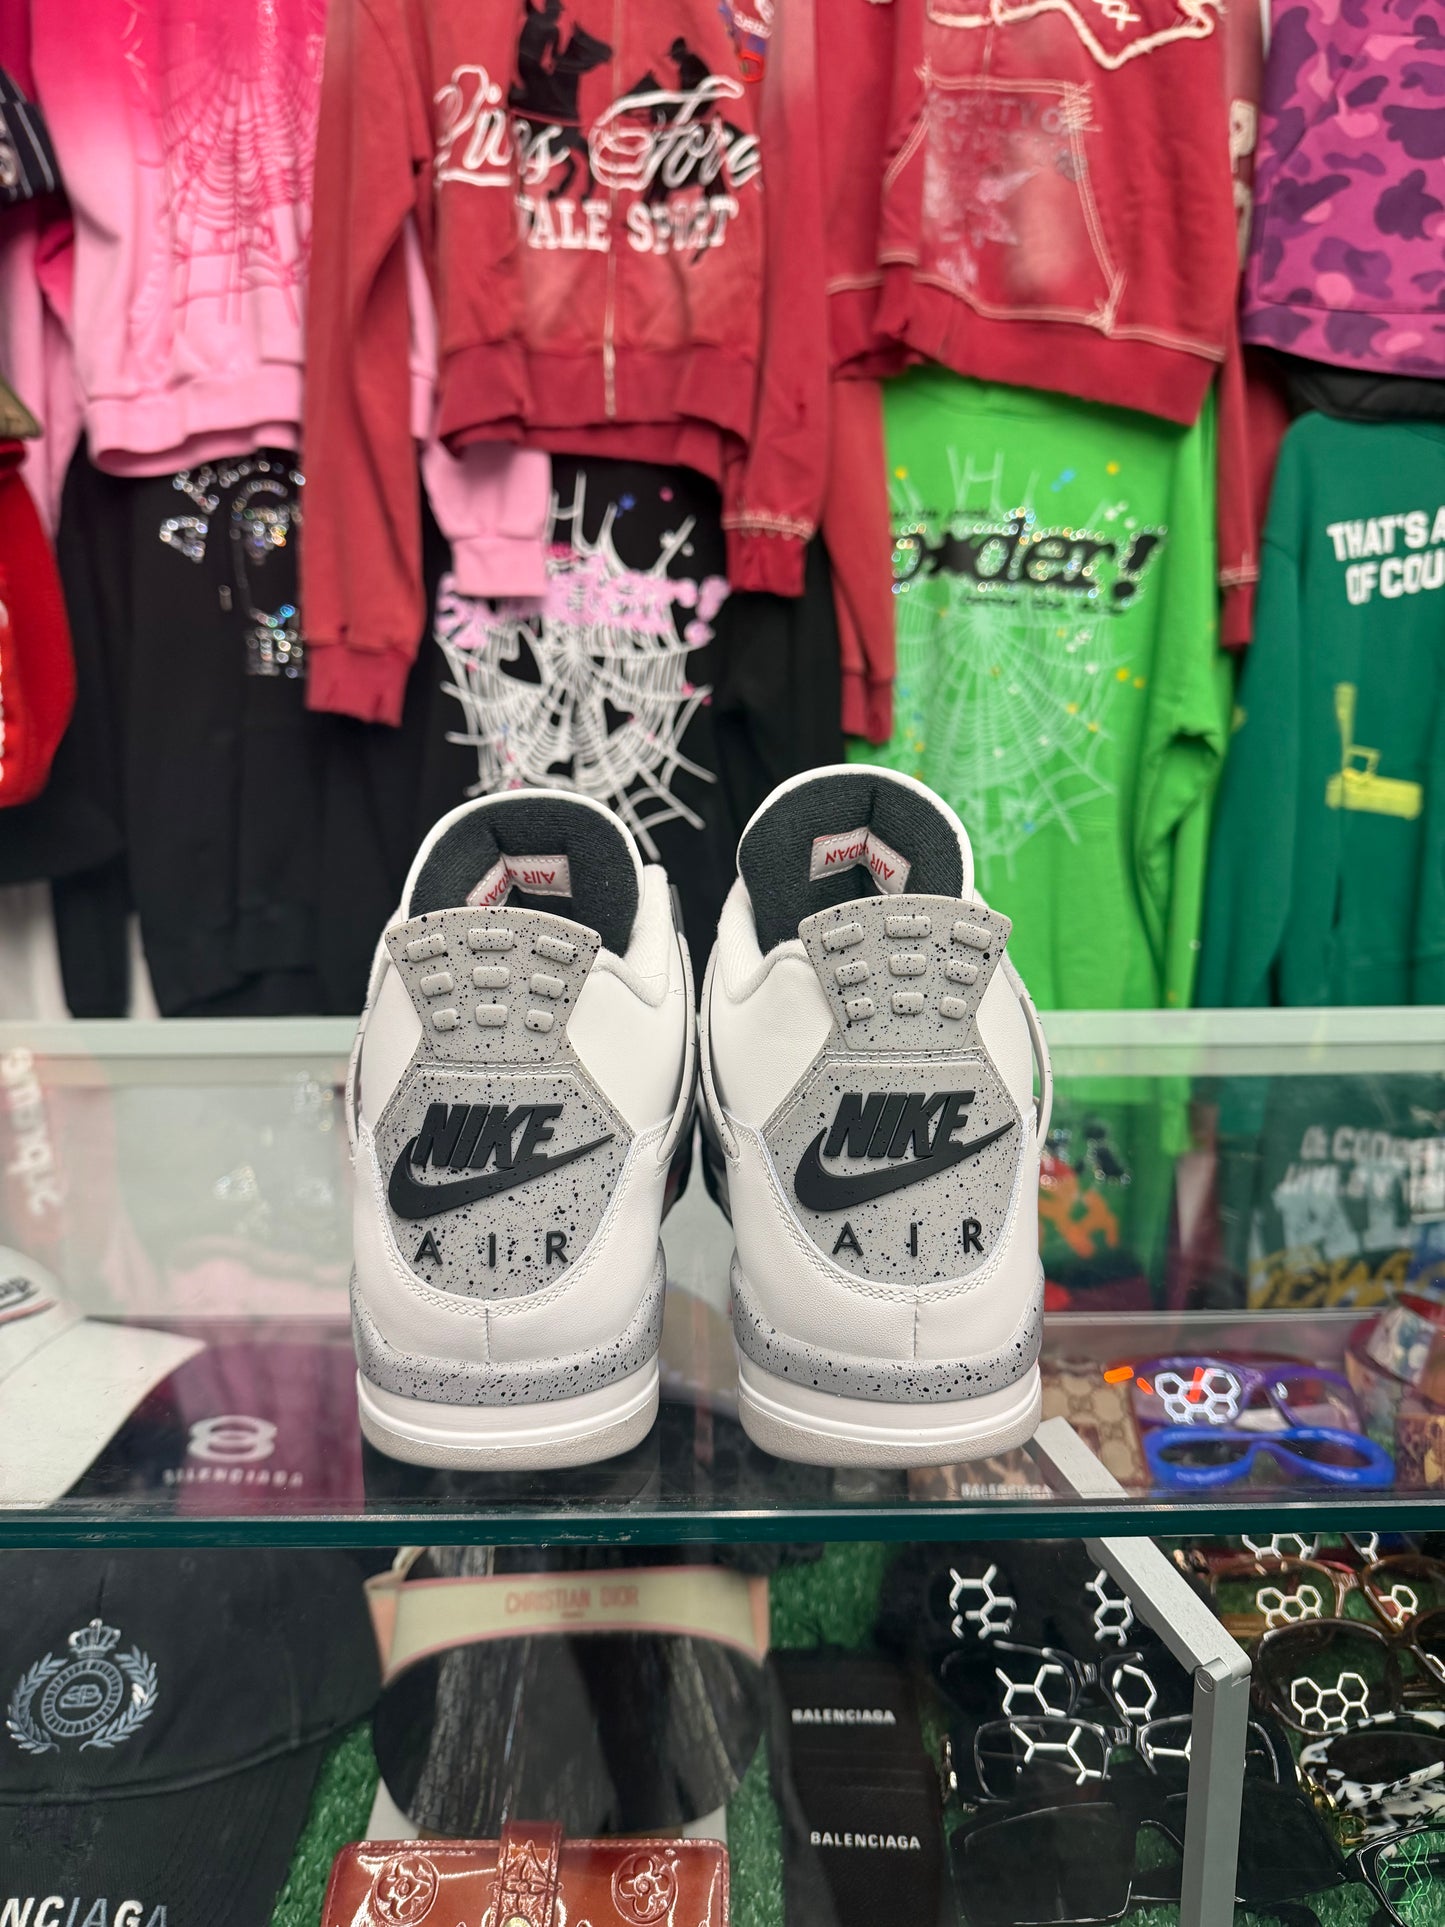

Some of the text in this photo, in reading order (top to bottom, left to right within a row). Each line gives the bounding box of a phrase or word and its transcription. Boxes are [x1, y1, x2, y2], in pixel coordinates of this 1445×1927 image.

[1326, 509, 1430, 562] THAT'S
[1345, 560, 1379, 606] OF
[522, 867, 556, 885] AIR
[870, 853, 896, 881] AIR
[411, 1102, 564, 1169] NIKE
[821, 1090, 976, 1158] NIKE
[413, 1230, 569, 1268] AIR
[832, 1218, 985, 1258] AIR
[791, 1707, 897, 1725] BALENCIAGA
[810, 1831, 922, 1850] BALENCIAGA
[0, 1895, 168, 1927] NCIAGA
